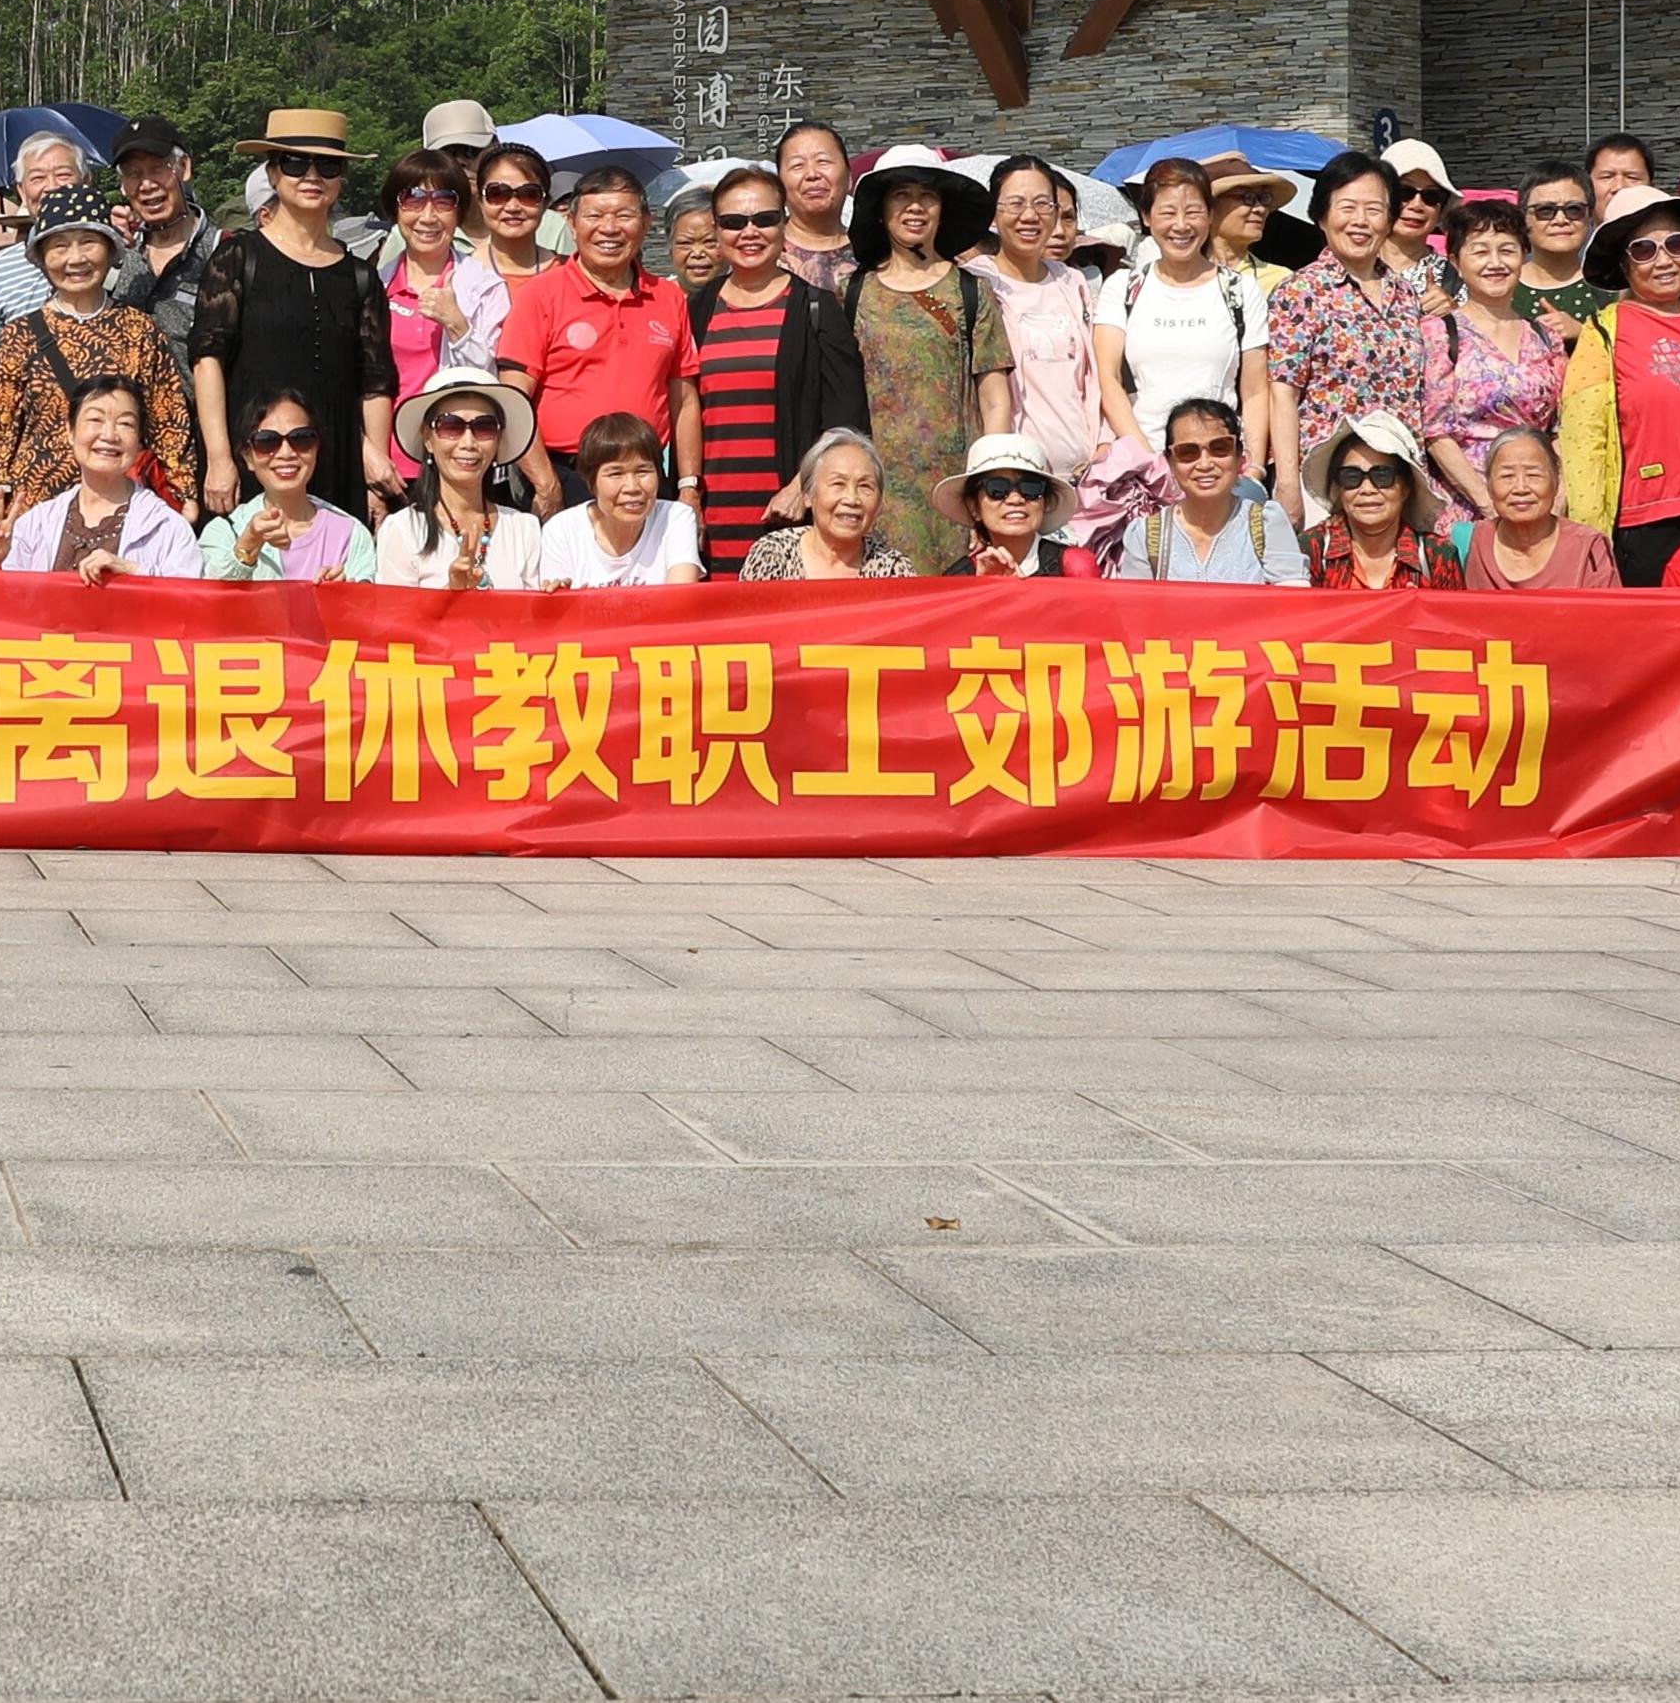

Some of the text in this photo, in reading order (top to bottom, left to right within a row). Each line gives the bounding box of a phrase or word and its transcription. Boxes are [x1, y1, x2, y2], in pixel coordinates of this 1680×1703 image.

[672, 74, 686, 131] EXPO
[757, 72, 770, 154] East Gate
[772, 62, 804, 153] 东大
[1379, 116, 1393, 153] 3
[1153, 317, 1207, 328] SISTER
